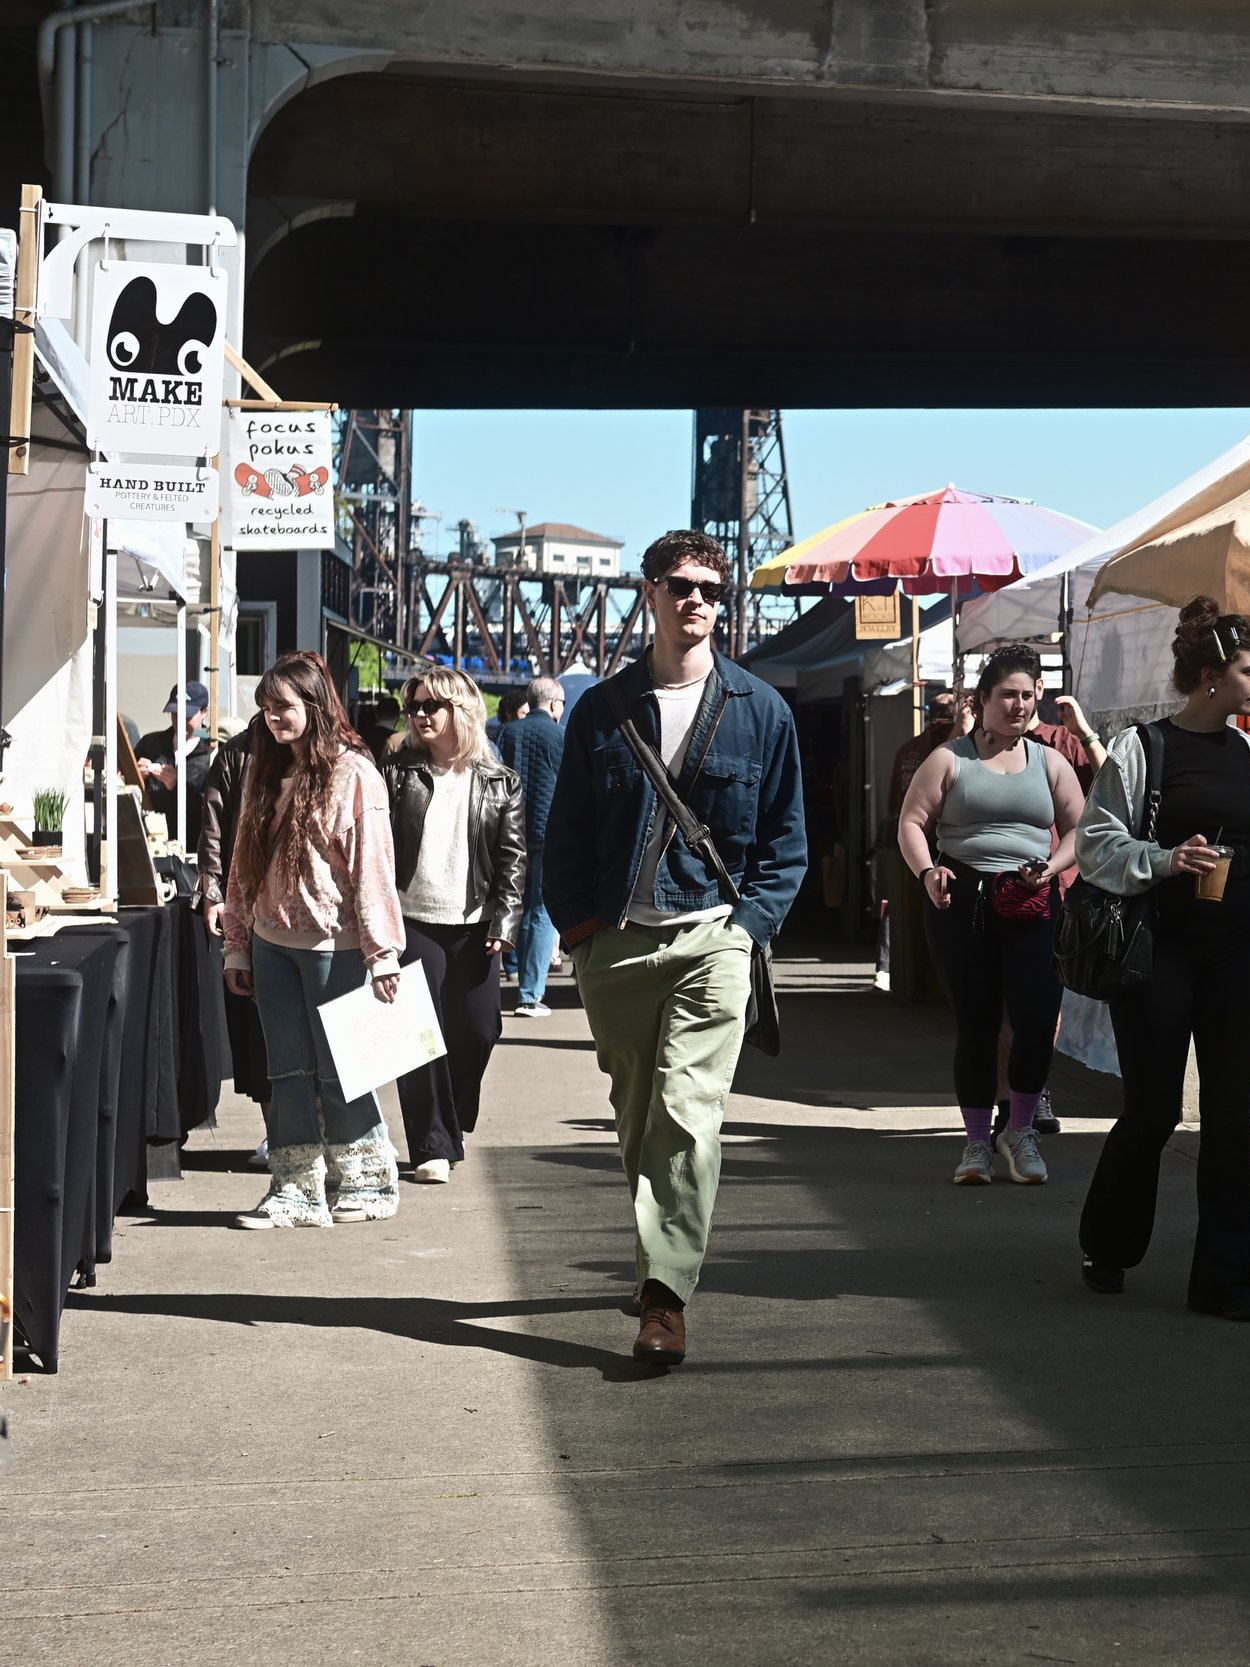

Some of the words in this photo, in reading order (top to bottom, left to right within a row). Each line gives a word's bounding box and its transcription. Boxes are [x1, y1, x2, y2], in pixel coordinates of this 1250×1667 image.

[109, 376, 202, 405] MAKE
[106, 404, 201, 428] ART.PDX
[247, 420, 316, 439] focus
[249, 439, 315, 462] pokus
[99, 478, 149, 490] HAND
[154, 480, 206, 493] BUILT
[115, 491, 151, 501] POTTERY
[153, 493, 159, 501] &
[160, 494, 189, 502] FELTED
[130, 502, 176, 511] CREATURES
[251, 503, 314, 519] recycled
[238, 523, 328, 535] skateboards
[858, 625, 895, 633] JEWELRY
